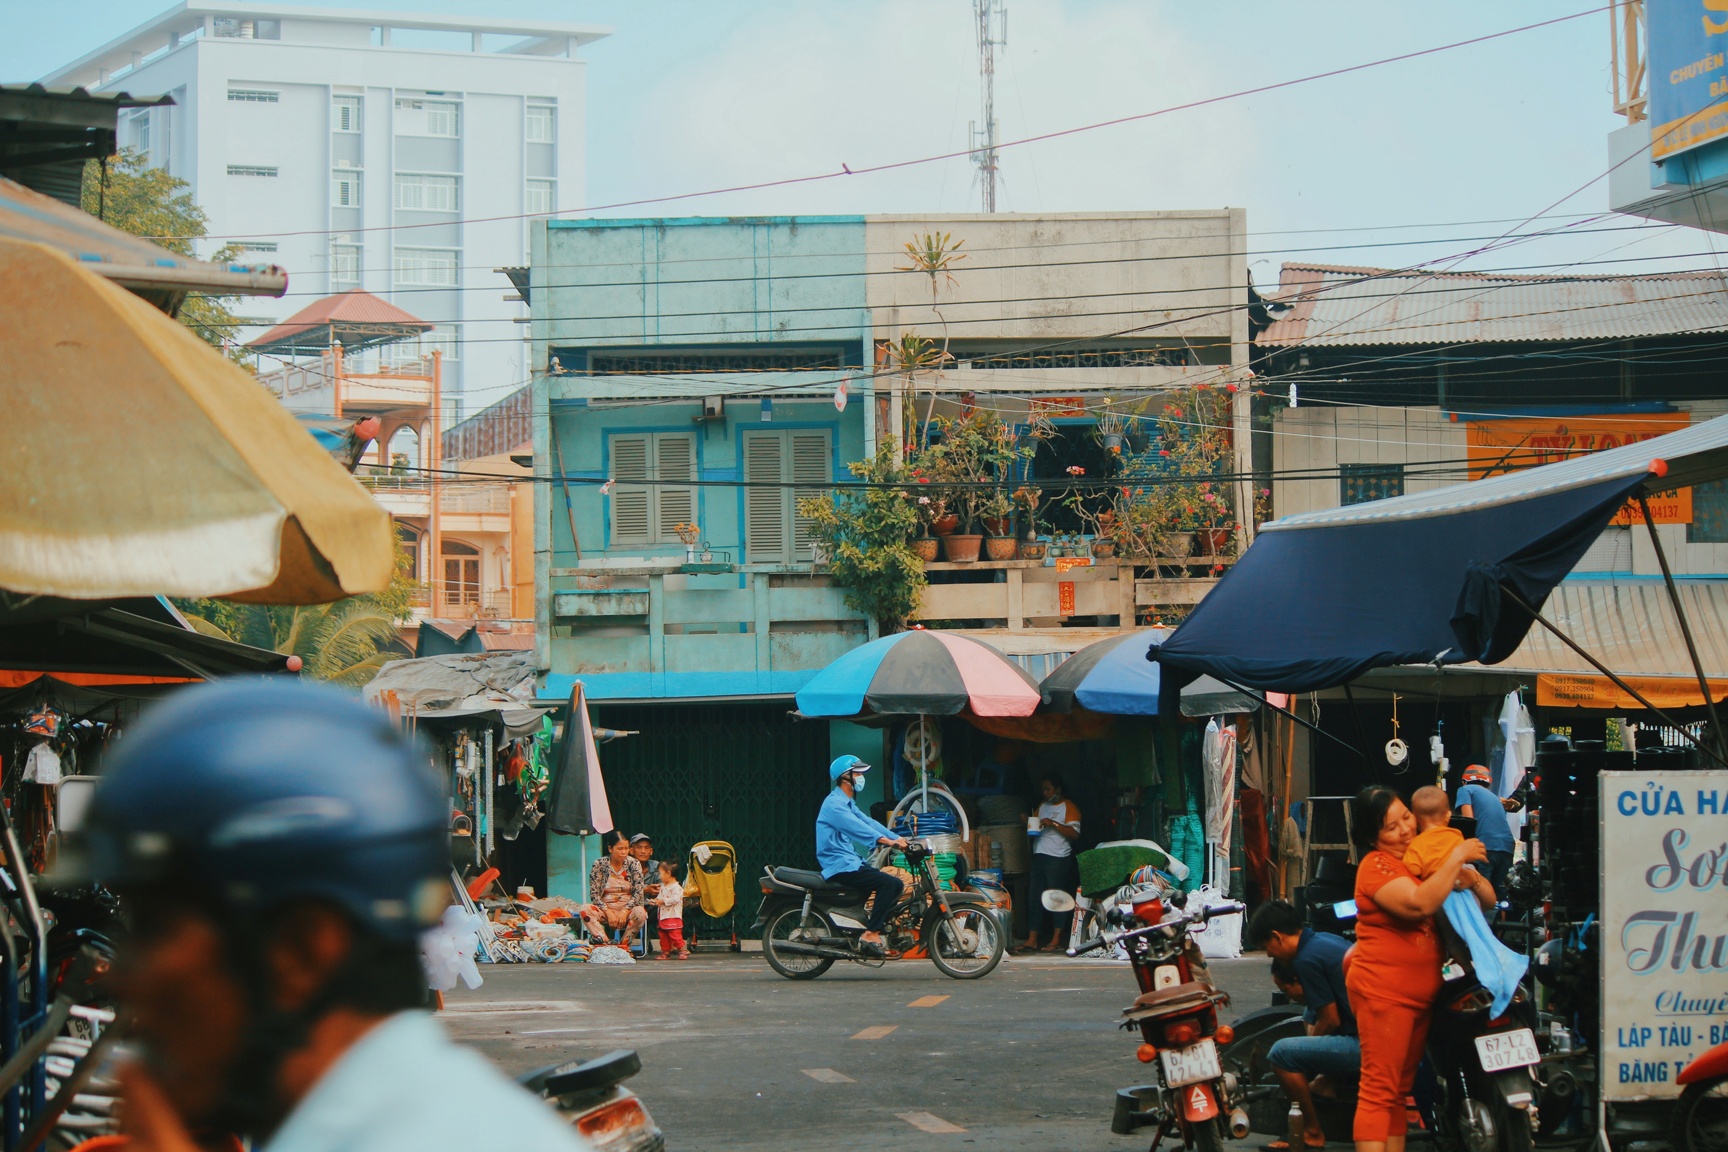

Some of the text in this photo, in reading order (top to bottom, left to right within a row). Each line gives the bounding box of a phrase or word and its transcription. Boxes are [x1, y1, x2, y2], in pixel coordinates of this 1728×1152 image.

[1670, 52, 1724, 84] CHUYÊN
[1709, 75, 1728, 97] BĂ
[1617, 781, 1685, 816] CỬA
[1485, 1033, 1526, 1053] 67-L2
[1658, 1021, 1691, 1047] TÀU
[1619, 1059, 1668, 1083] BĂNG
